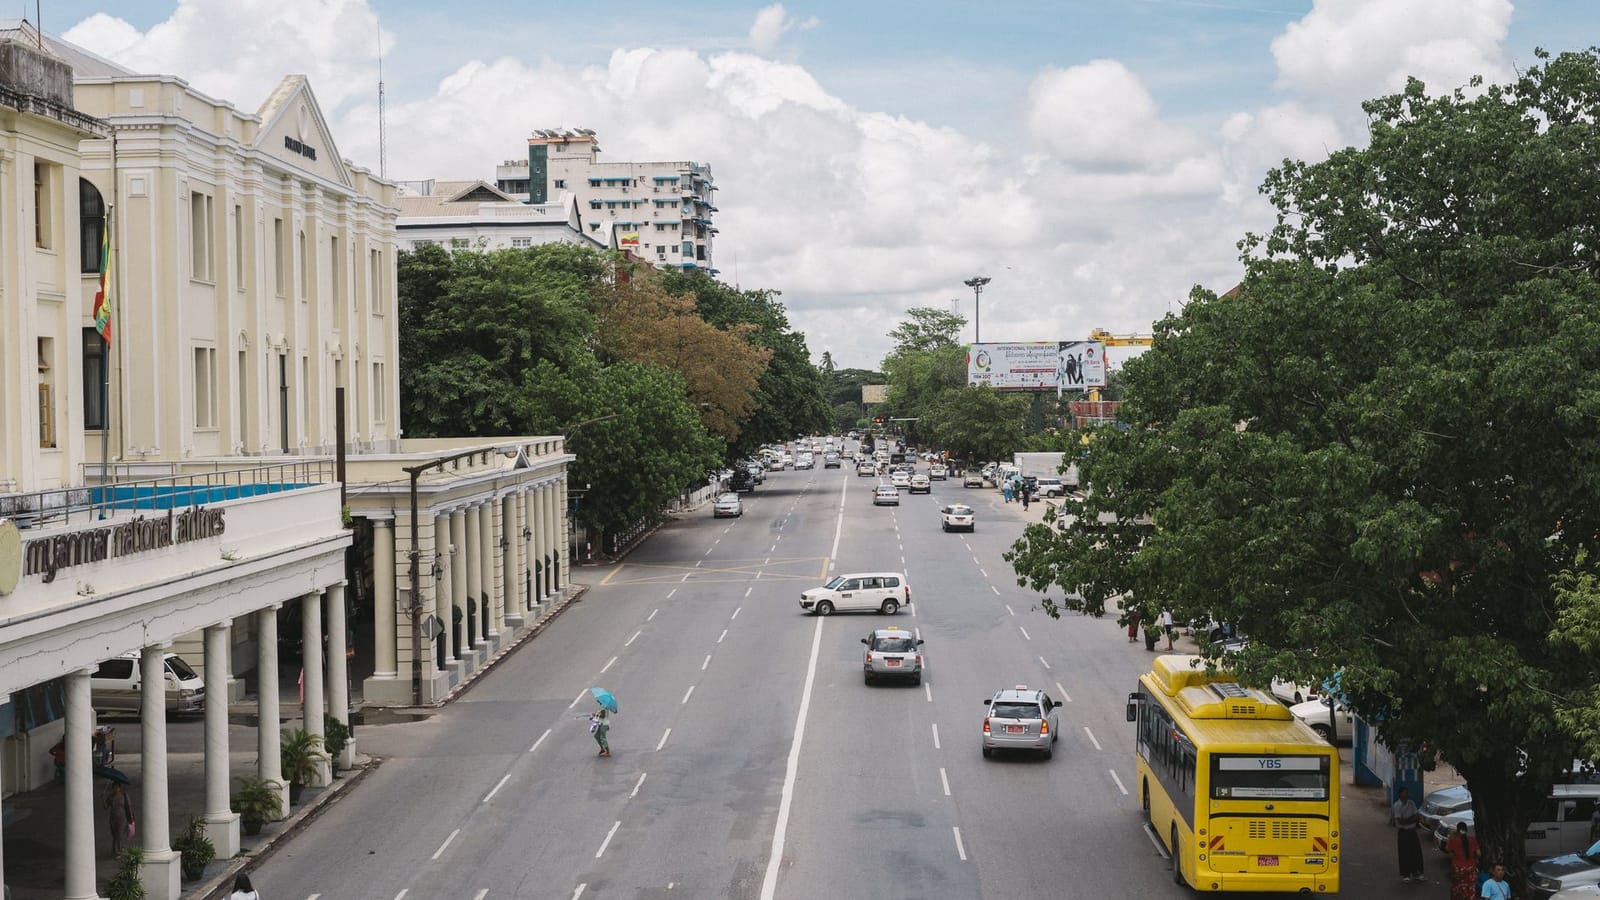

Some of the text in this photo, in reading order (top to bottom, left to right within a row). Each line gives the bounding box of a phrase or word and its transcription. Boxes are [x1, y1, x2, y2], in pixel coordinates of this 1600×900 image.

[23, 504, 226, 583] myanmar national airlines
[1259, 759, 1282, 769] YBS
